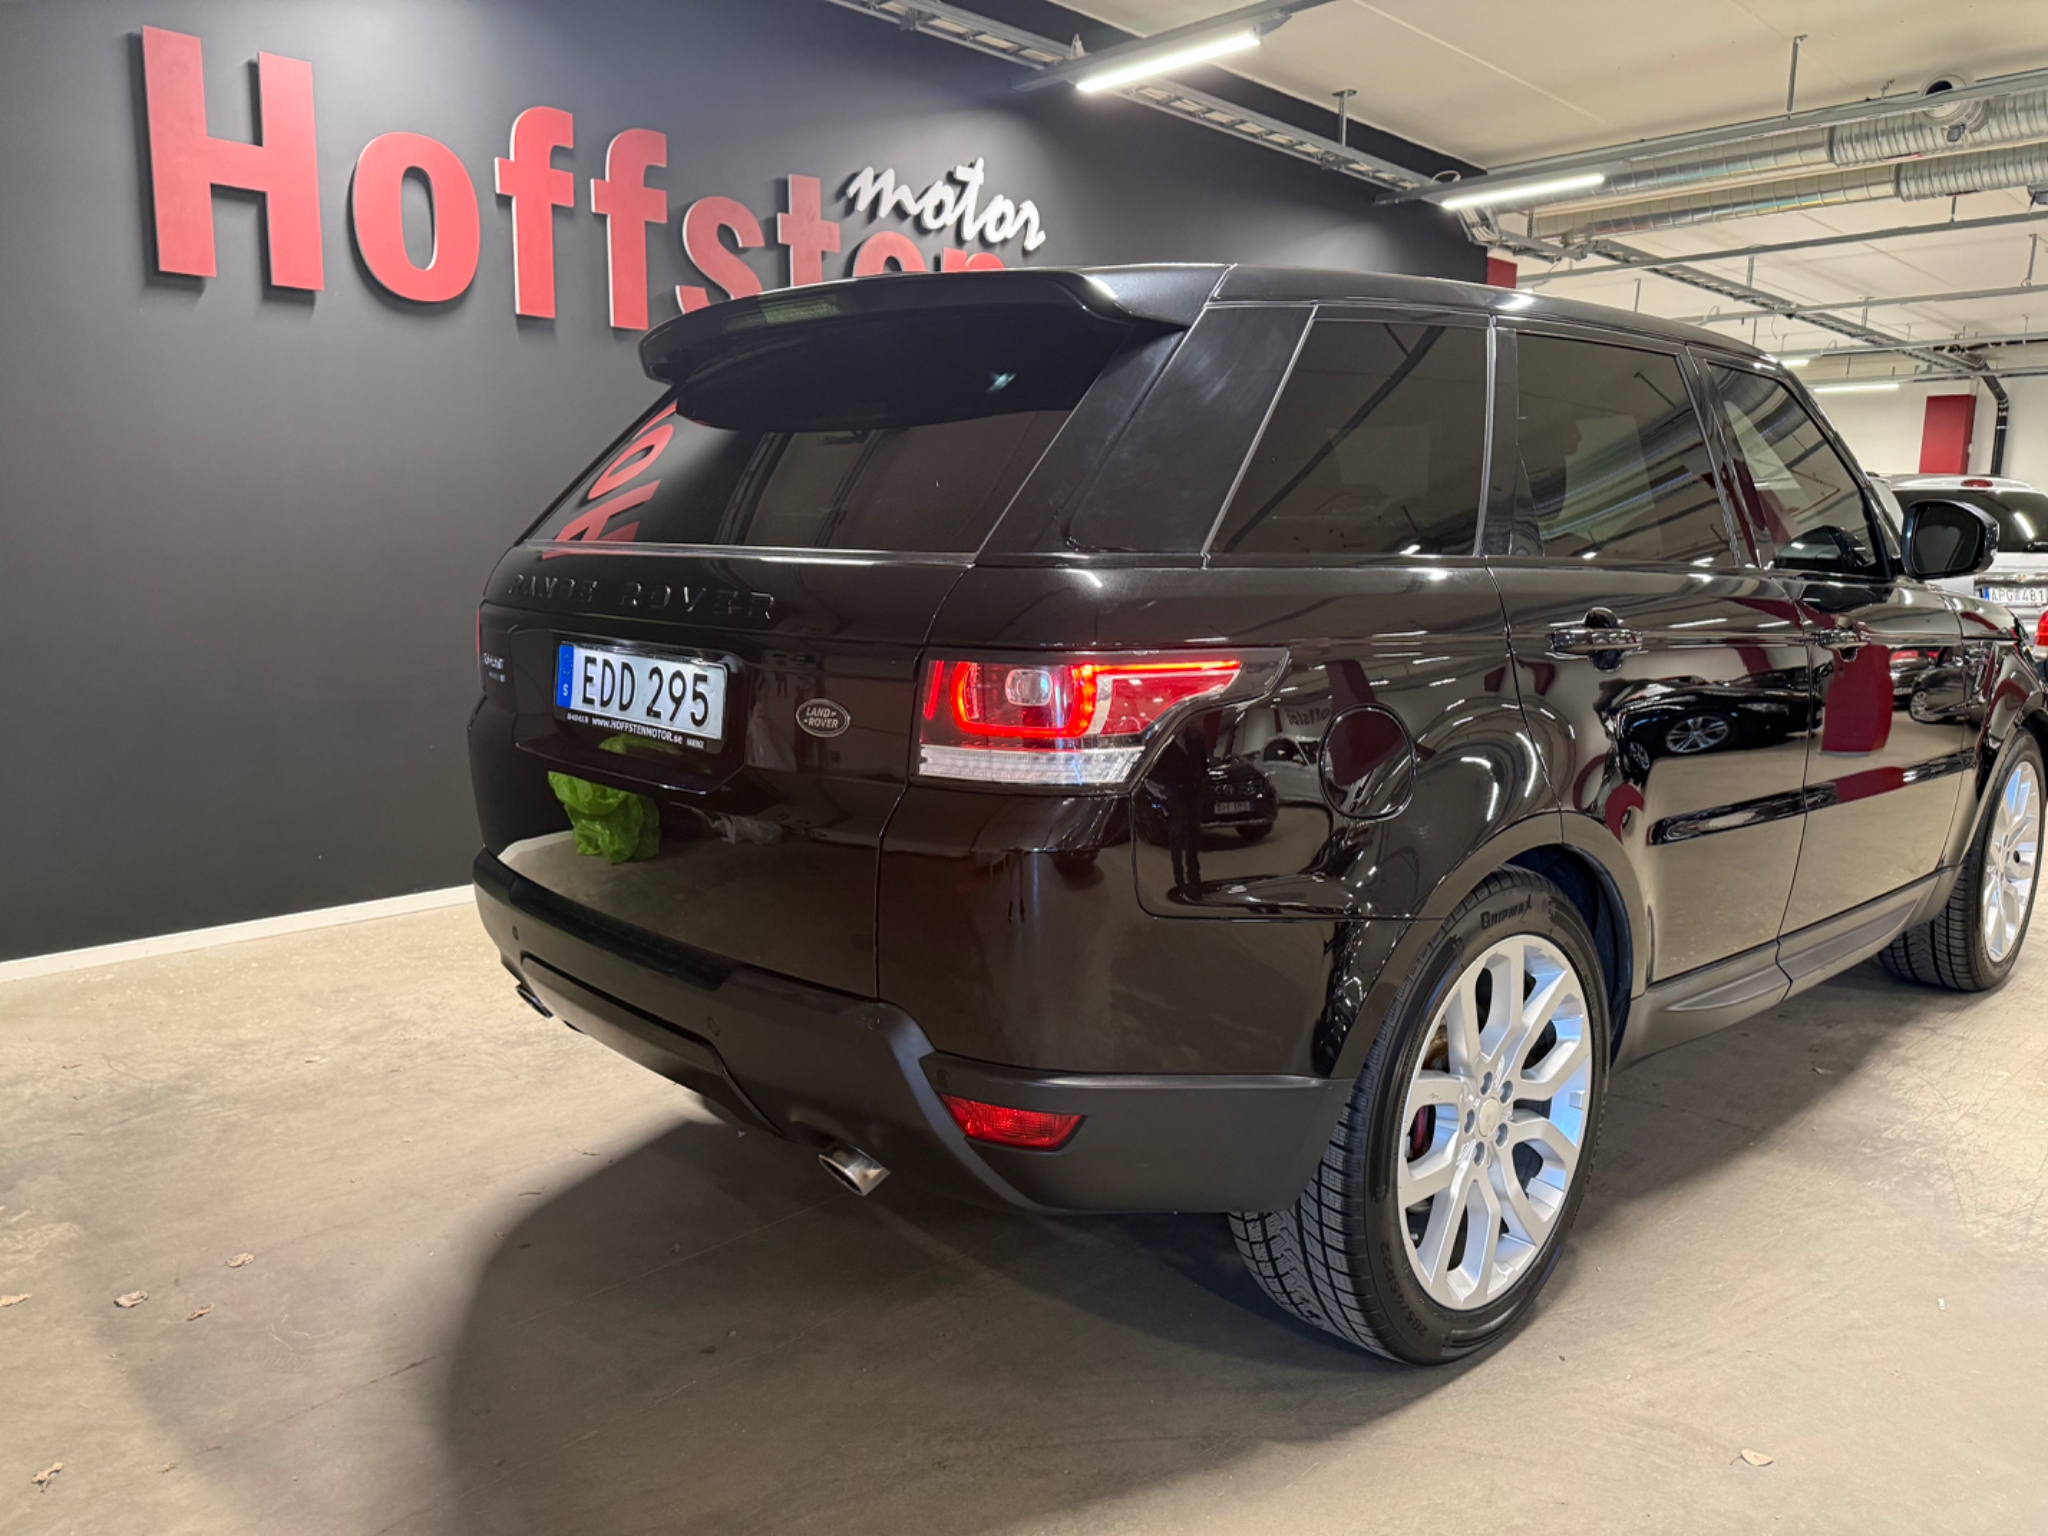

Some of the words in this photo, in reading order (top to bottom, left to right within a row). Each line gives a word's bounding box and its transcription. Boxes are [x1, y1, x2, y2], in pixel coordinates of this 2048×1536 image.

[142, 25, 1005, 331] Hoffst
[846, 157, 1046, 253] motor
[618, 581, 776, 620] ROVER
[562, 682, 570, 697] S
[582, 655, 636, 711] EDD
[646, 666, 709, 727] 295
[805, 706, 831, 717] LAND
[808, 716, 839, 728] ROVER
